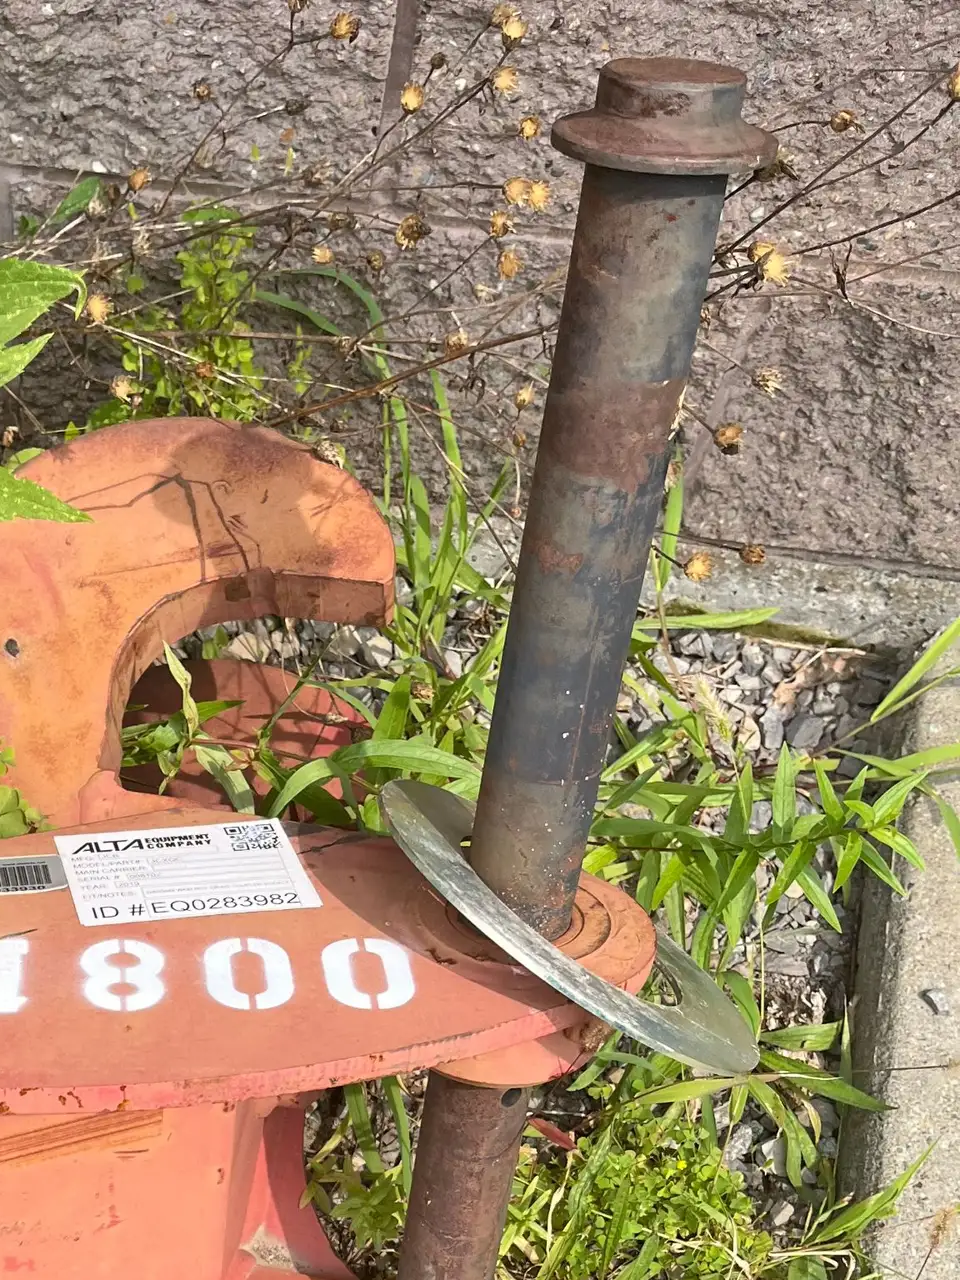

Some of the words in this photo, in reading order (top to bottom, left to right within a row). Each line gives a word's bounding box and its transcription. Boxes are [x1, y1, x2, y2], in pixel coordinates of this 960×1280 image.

[144, 833, 209, 844] EQUIPMENT
[72, 838, 145, 855] ALTA
[146, 839, 211, 850] COMPANY
[75, 868, 100, 876] MAIN
[91, 905, 120, 920] ID
[128, 903, 146, 916] #
[151, 891, 300, 914] EQ0283982
